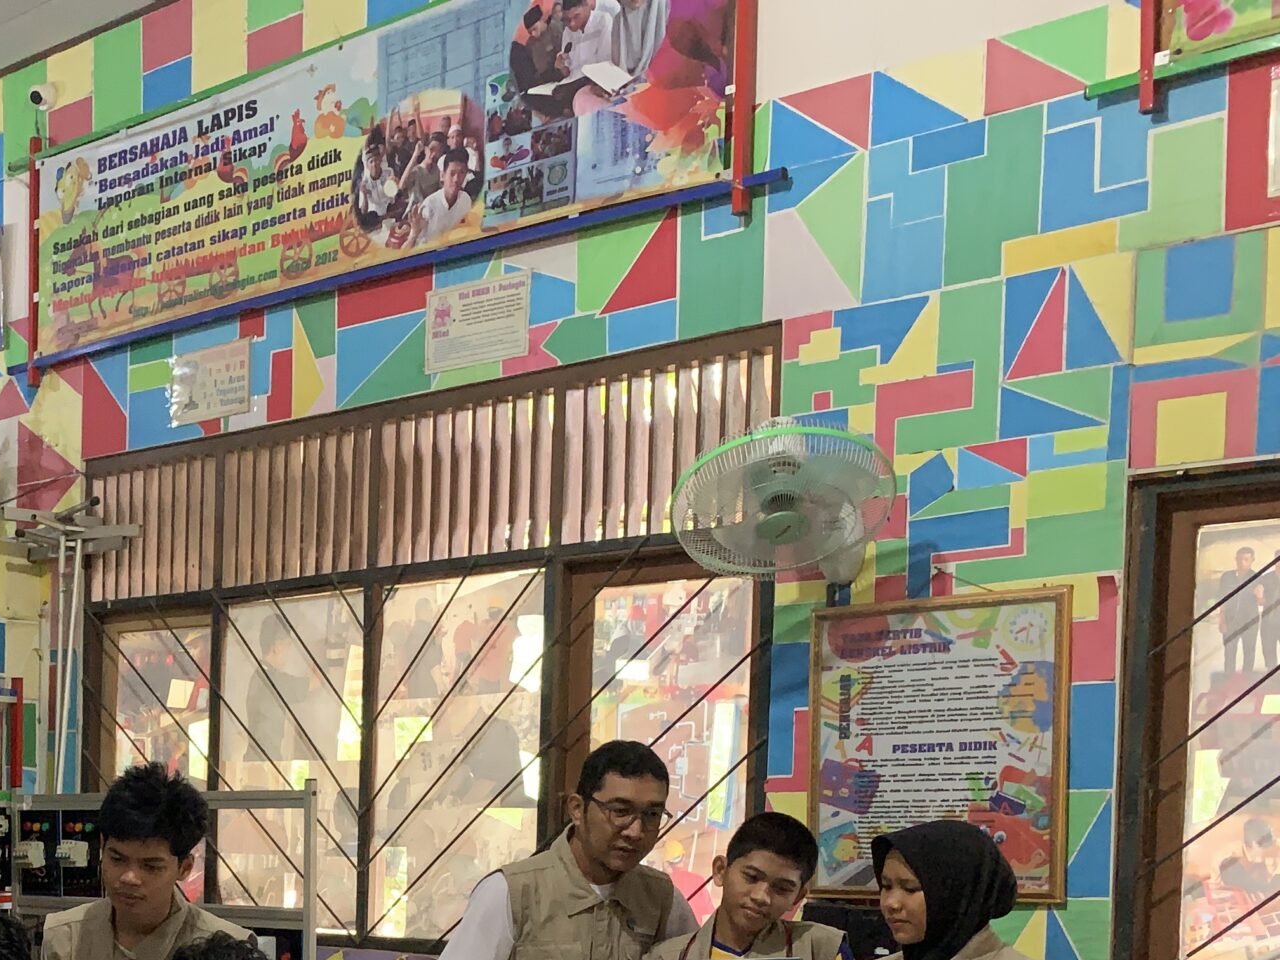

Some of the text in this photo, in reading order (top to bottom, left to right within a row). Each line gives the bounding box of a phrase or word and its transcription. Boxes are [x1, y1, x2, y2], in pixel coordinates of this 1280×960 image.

[97, 100, 258, 174] BERSAHAJA LAPIS
[195, 135, 226, 159] Jadi
[159, 157, 217, 189] Internal
[53, 149, 342, 255] Sadakah dari sebagian uang saku peserta didik
[103, 233, 152, 258] membantu
[155, 220, 191, 245] peserta
[195, 207, 220, 228] didik
[223, 201, 243, 220] lain
[247, 194, 274, 215] yang
[277, 182, 305, 203] tidak
[309, 169, 352, 196] mampu
[53, 269, 101, 294] Laporan
[156, 238, 205, 262] catatan
[209, 224, 247, 246] sikap
[252, 206, 306, 236] peserta
[311, 192, 350, 214] didik
[239, 240, 265, 257] dan
[314, 249, 339, 267] 2012
[892, 740, 998, 754] PESERTA DIDIK
